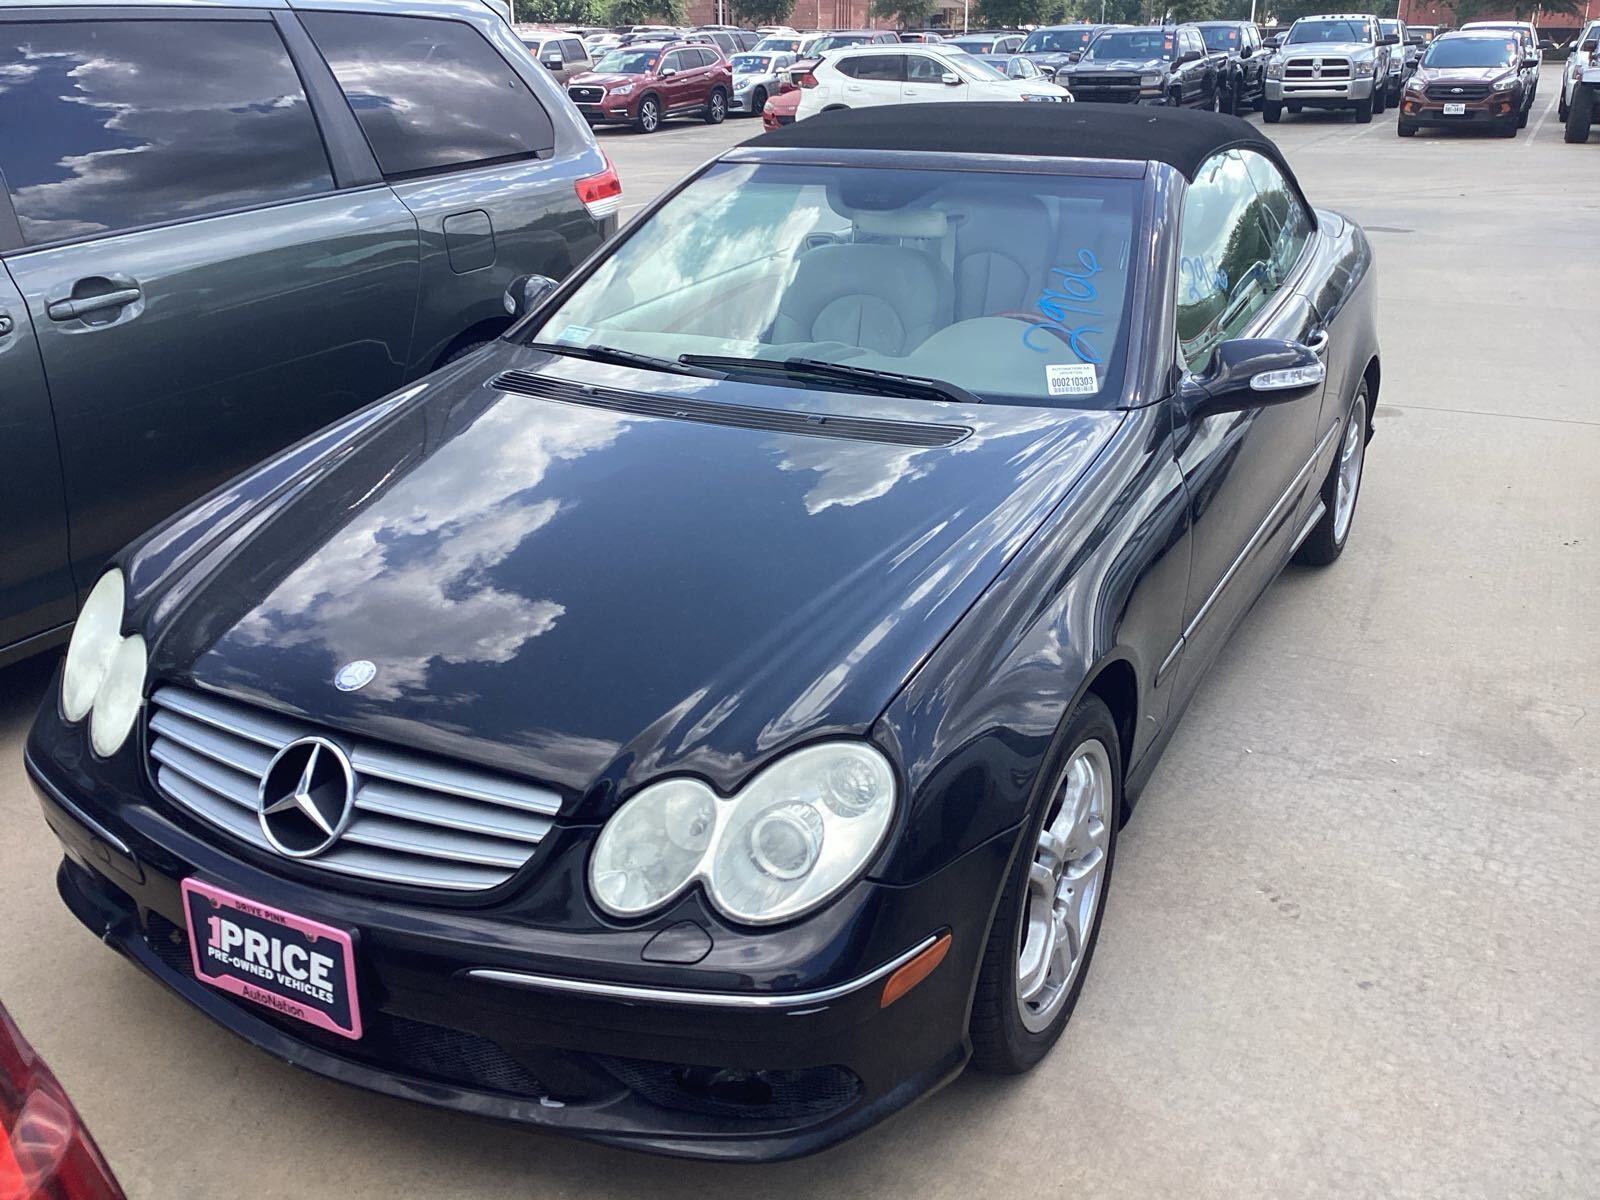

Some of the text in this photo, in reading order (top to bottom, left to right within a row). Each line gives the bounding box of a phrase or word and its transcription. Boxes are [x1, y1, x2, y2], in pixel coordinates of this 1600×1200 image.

[1052, 377, 1094, 387] 000210303
[235, 901, 287, 924] DRIVE PINK
[208, 946, 334, 1004] PRE-OWNED VEHICLES
[242, 985, 305, 1019] AutoNation
